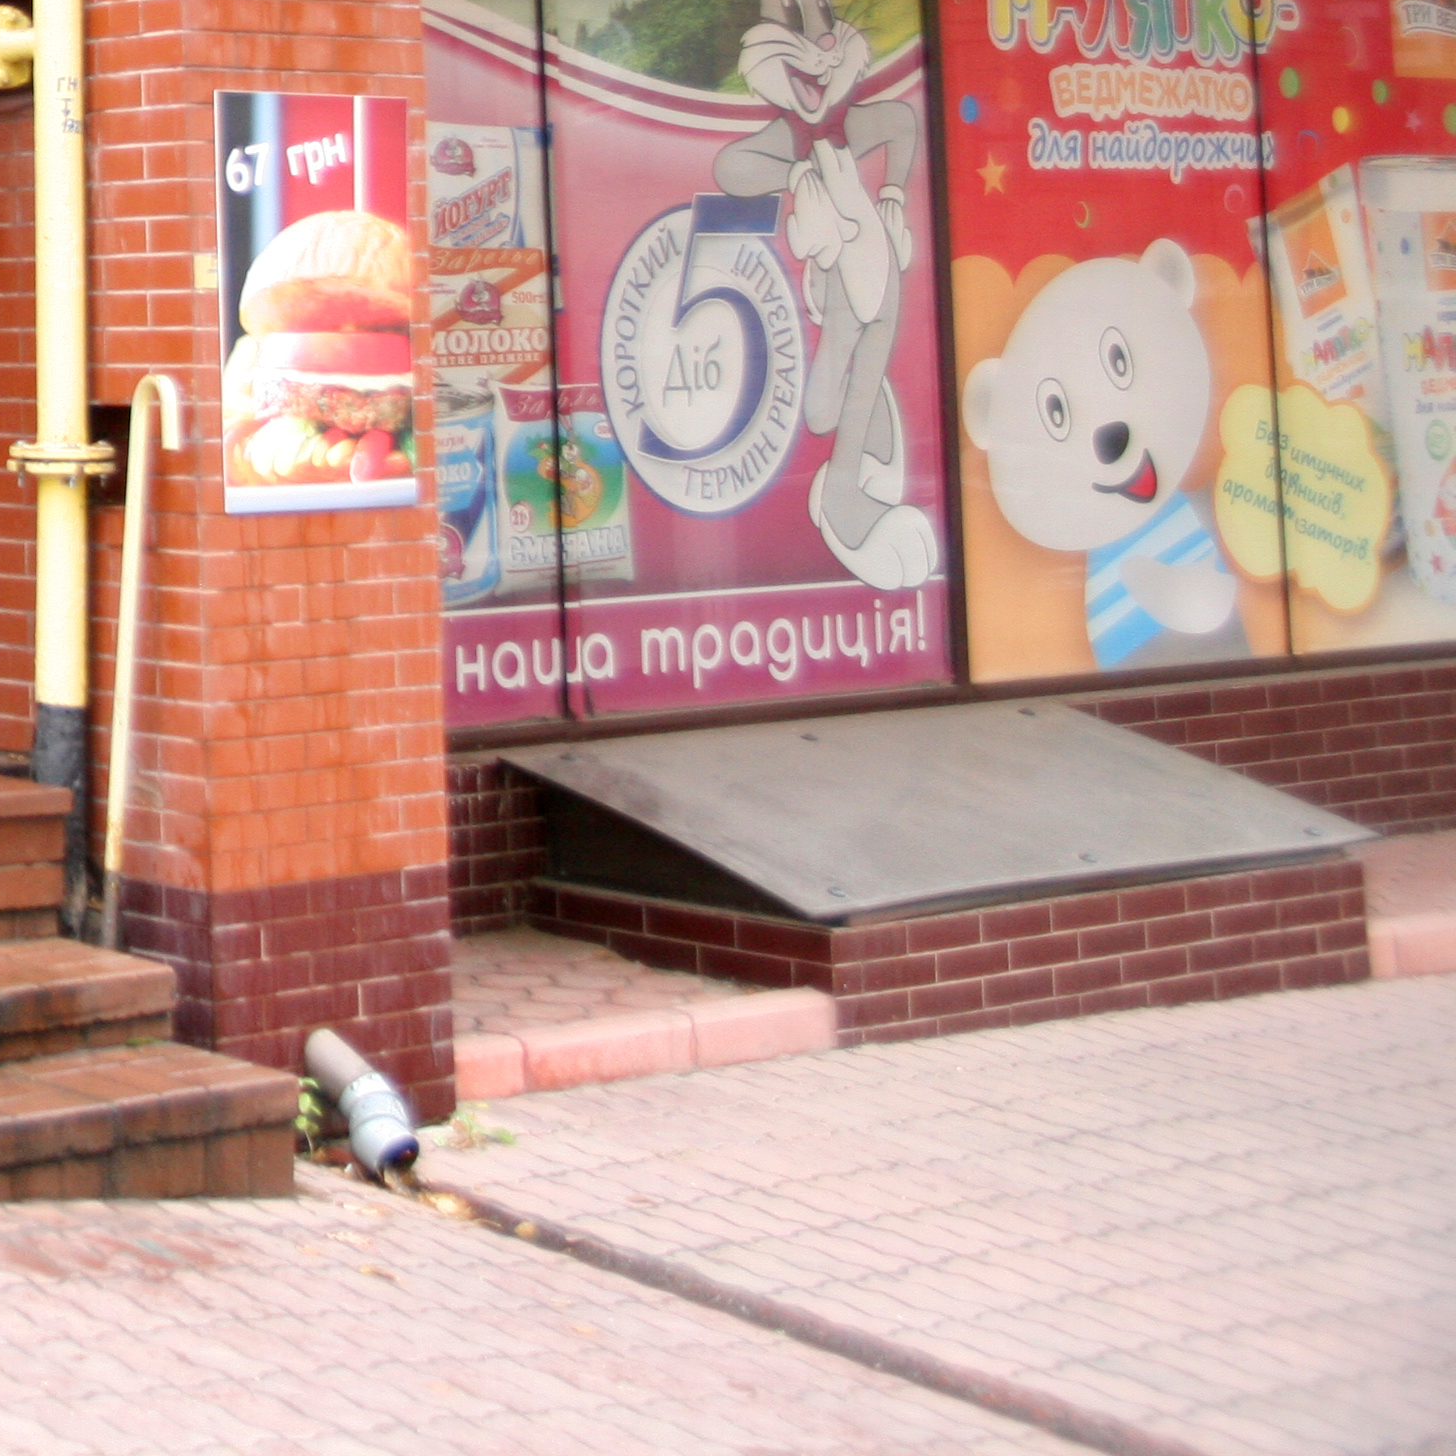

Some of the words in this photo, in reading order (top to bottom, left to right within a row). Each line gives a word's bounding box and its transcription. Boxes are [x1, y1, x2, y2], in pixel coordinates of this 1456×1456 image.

[1054, 70, 1252, 114] ВЕДМЕЖАТКО
[225, 143, 270, 192] 67
[286, 133, 348, 185] грн
[1032, 121, 1080, 162] для
[614, 223, 682, 419] КОРОТКИЙ
[636, 193, 782, 461] 5
[730, 244, 797, 431] РЕАЛІЗАЦІЇ
[663, 334, 721, 408] Діб
[683, 430, 778, 501] ТЕРМІН
[455, 632, 615, 693] наша
[641, 590, 927, 689] традиція!
